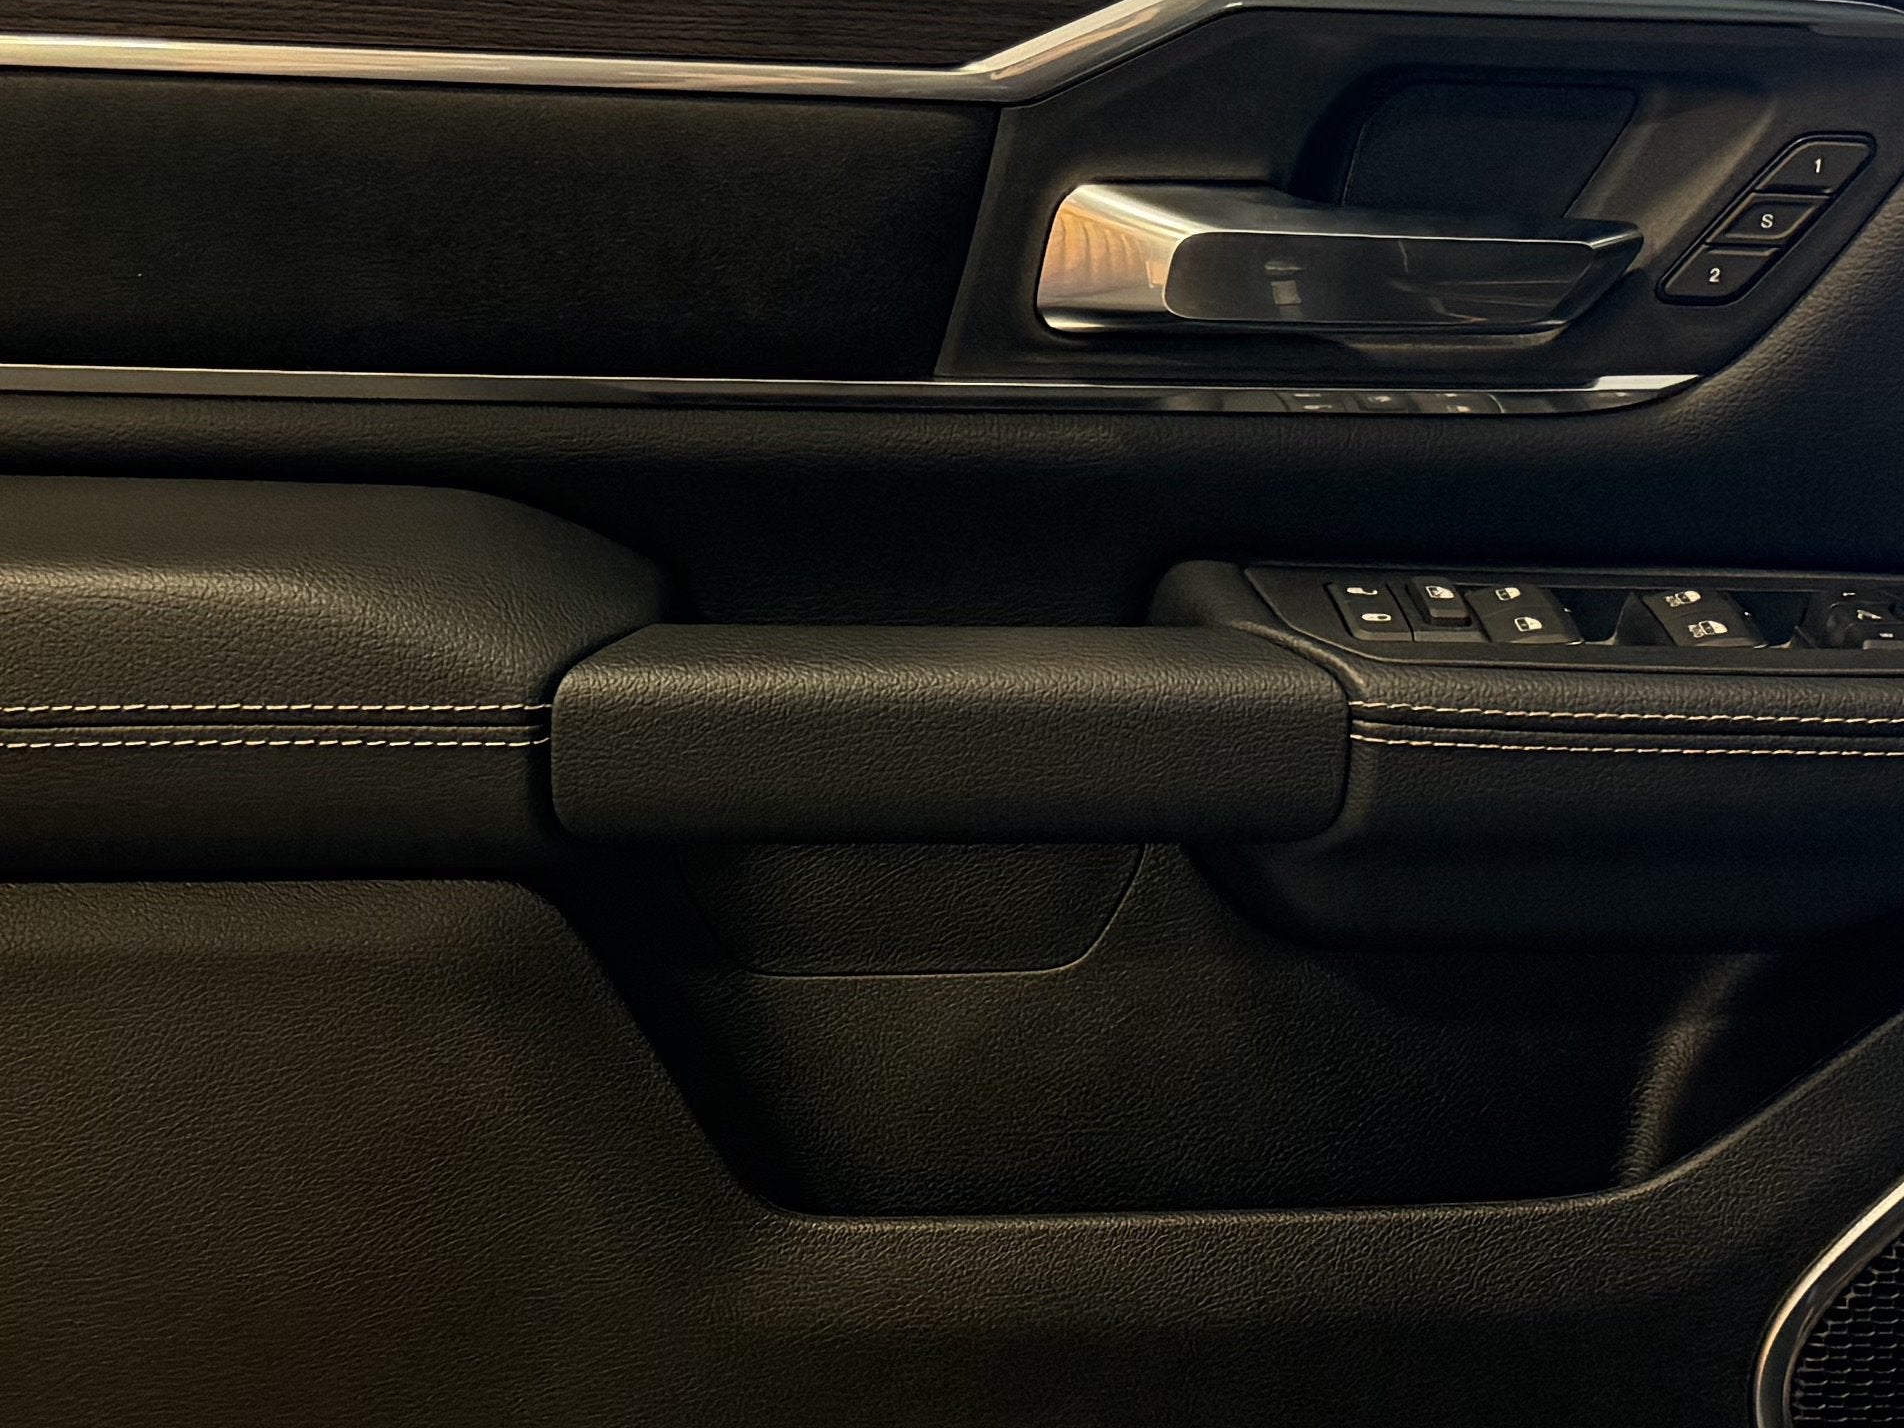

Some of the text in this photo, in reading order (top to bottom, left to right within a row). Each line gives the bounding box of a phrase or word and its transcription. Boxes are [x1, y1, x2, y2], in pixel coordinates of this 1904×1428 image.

[1813, 158, 1822, 174] 1
[1760, 213, 1774, 229] S
[1708, 268, 1721, 283] 2
